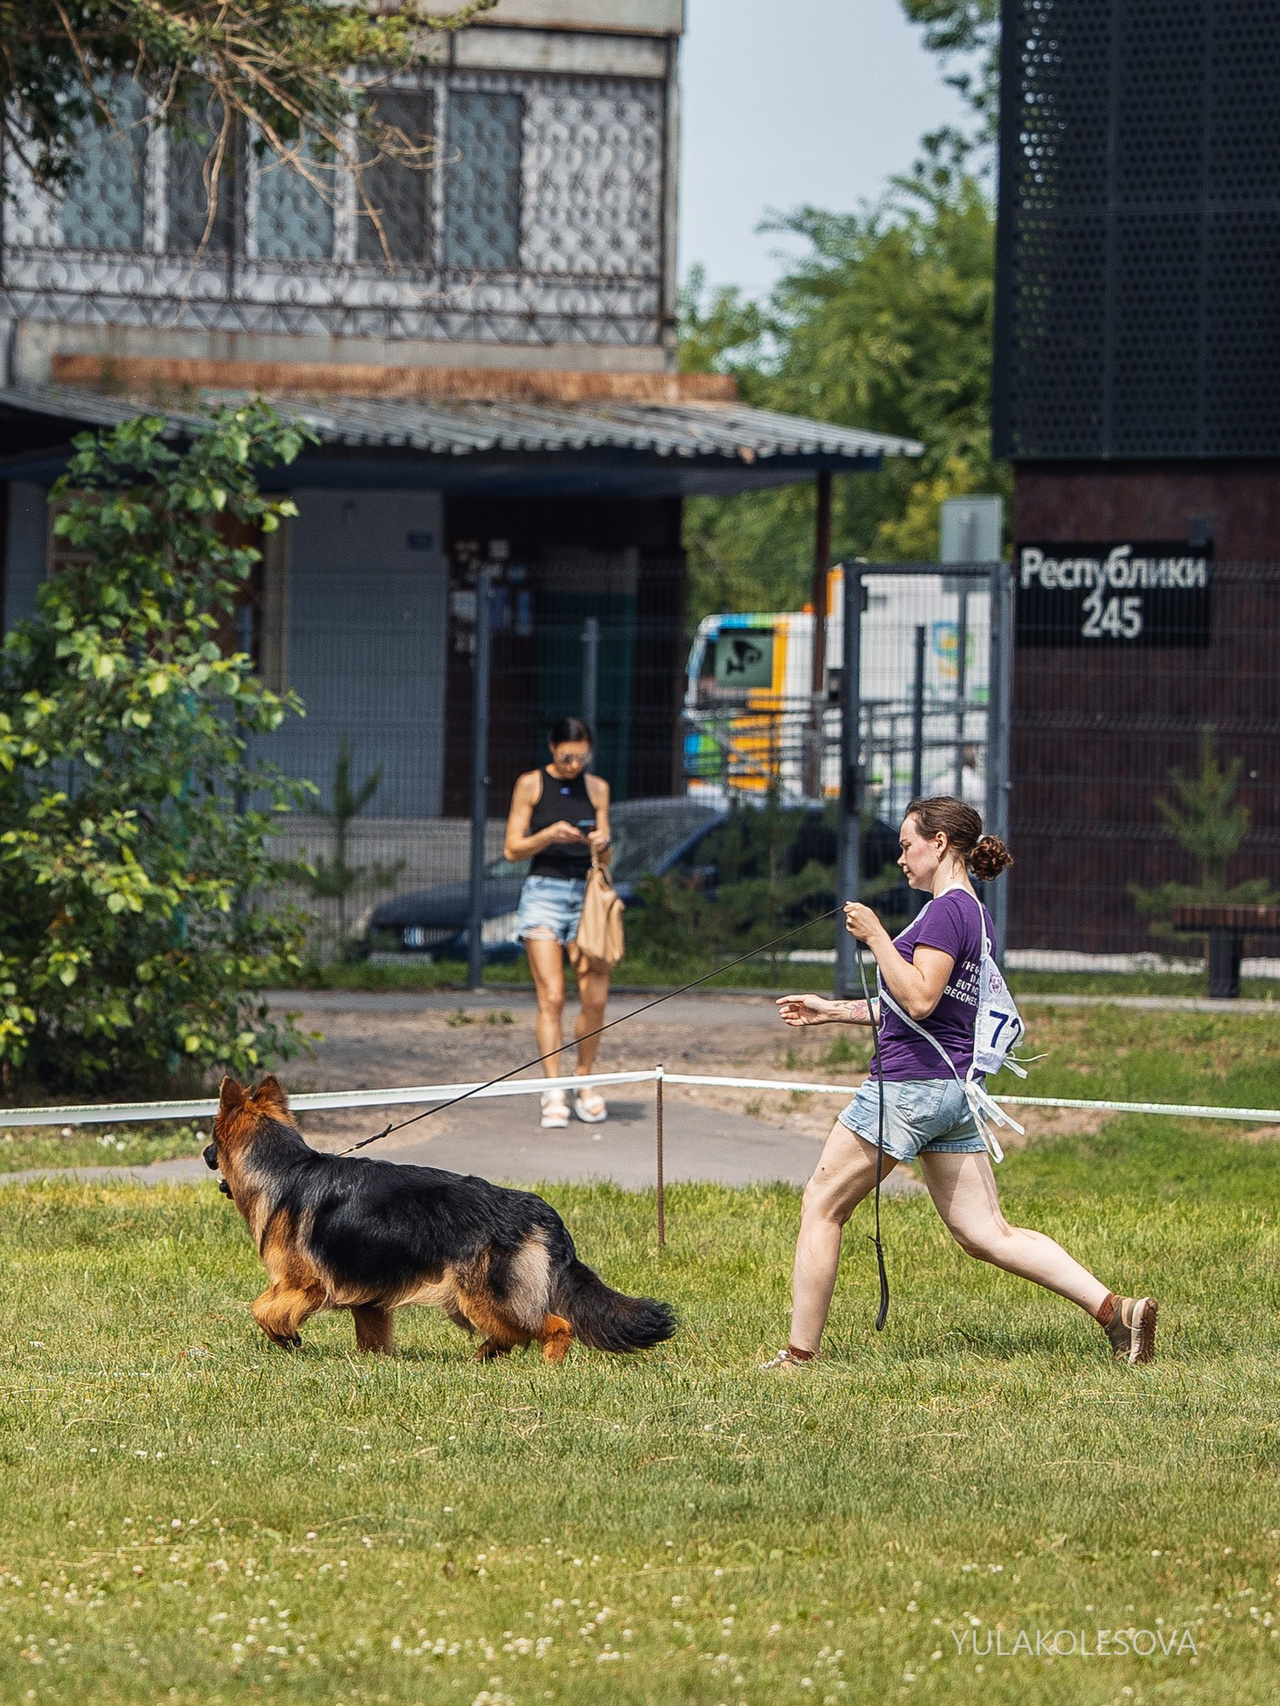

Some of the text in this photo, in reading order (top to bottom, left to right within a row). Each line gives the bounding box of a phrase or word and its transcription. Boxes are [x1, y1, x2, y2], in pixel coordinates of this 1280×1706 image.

[1021, 544, 1207, 600] Республики
[1081, 596, 1143, 639] 245
[943, 985, 978, 1006] BECOMES
[989, 1010, 1021, 1053] 72
